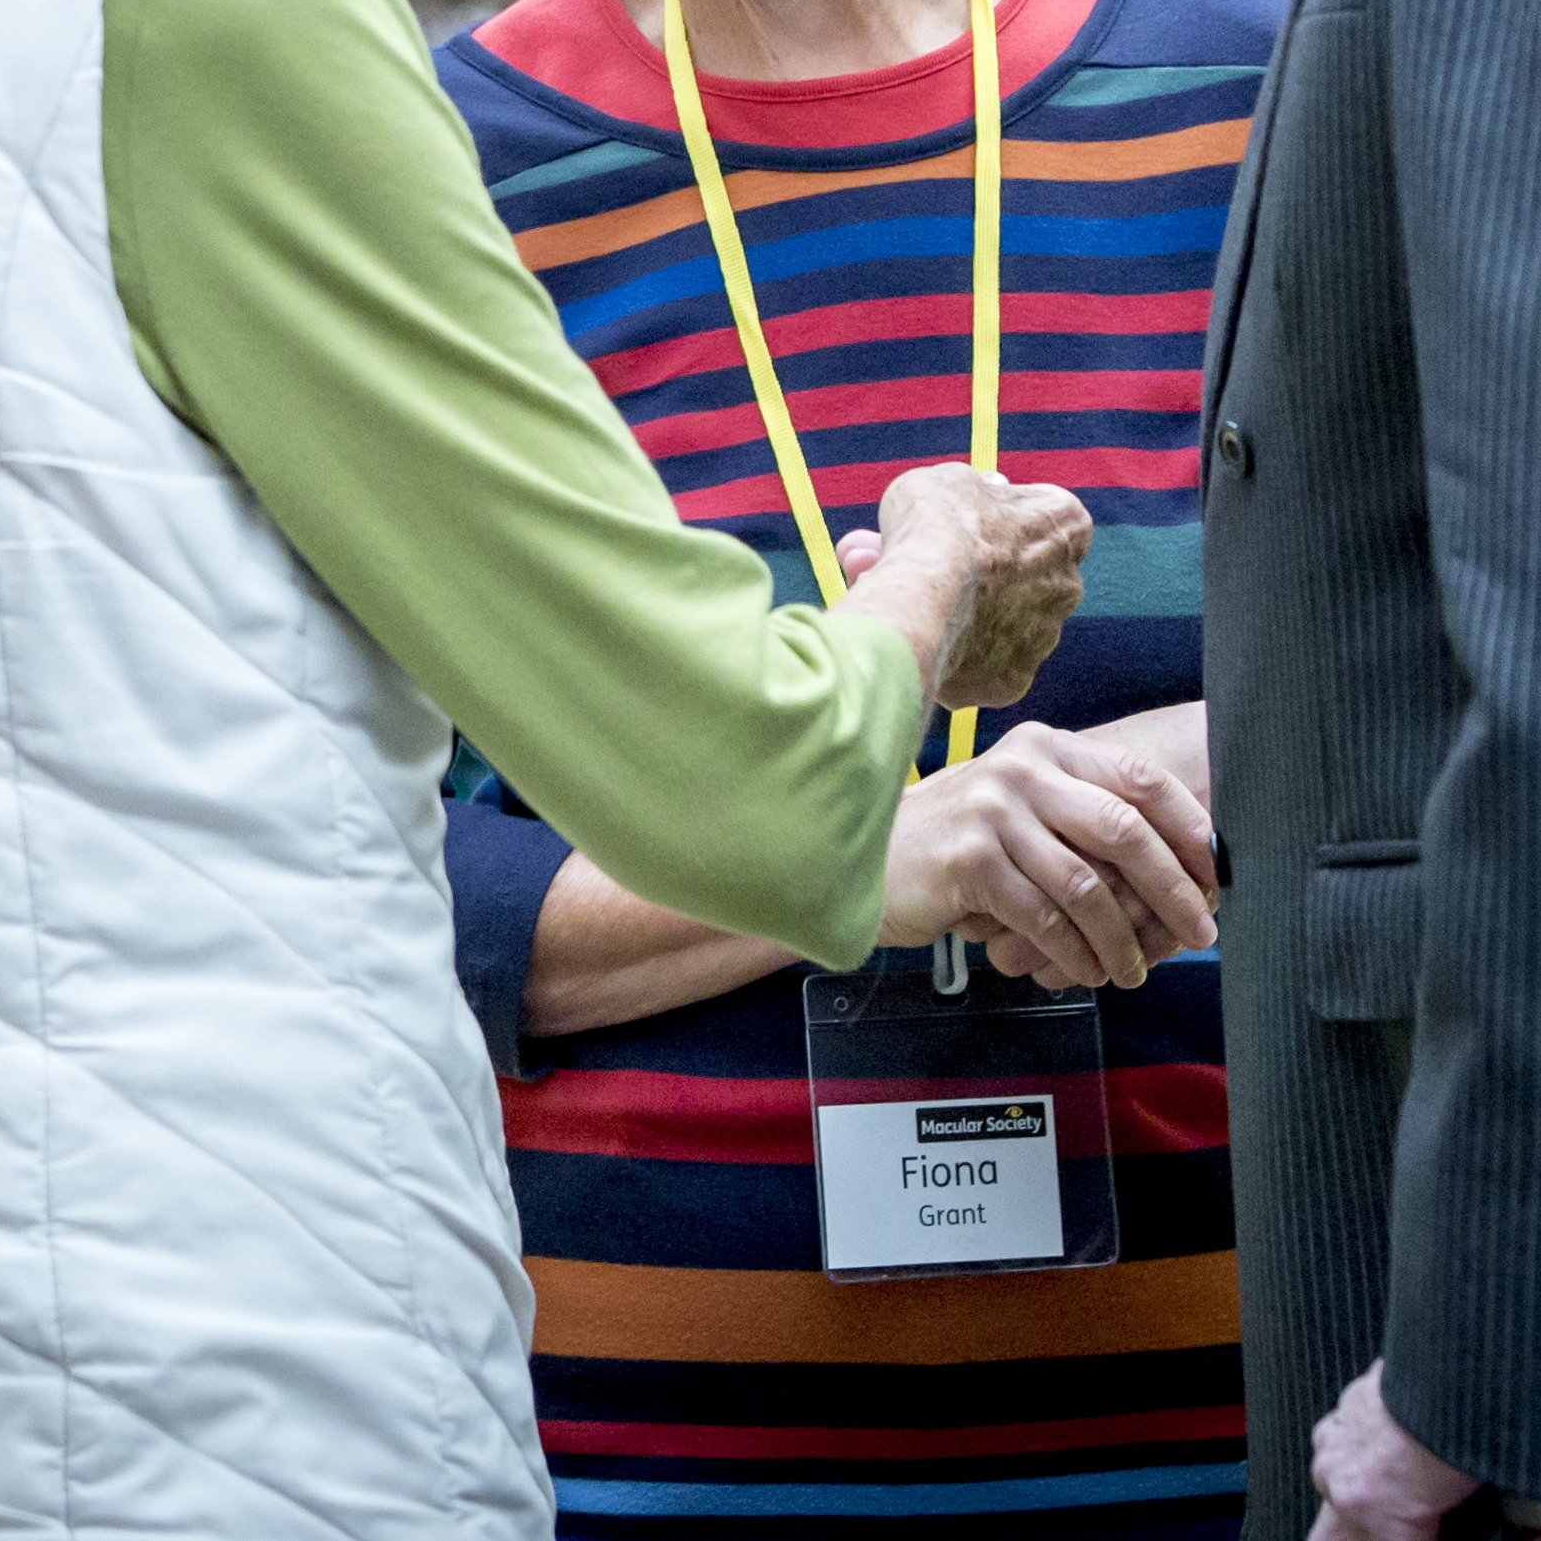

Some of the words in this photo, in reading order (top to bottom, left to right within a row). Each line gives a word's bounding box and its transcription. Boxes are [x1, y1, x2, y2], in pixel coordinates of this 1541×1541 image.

[921, 1117, 983, 1136] Macular
[986, 1116, 1042, 1134] Society
[902, 1155, 997, 1189] Fiona
[919, 1203, 987, 1227] Grant
